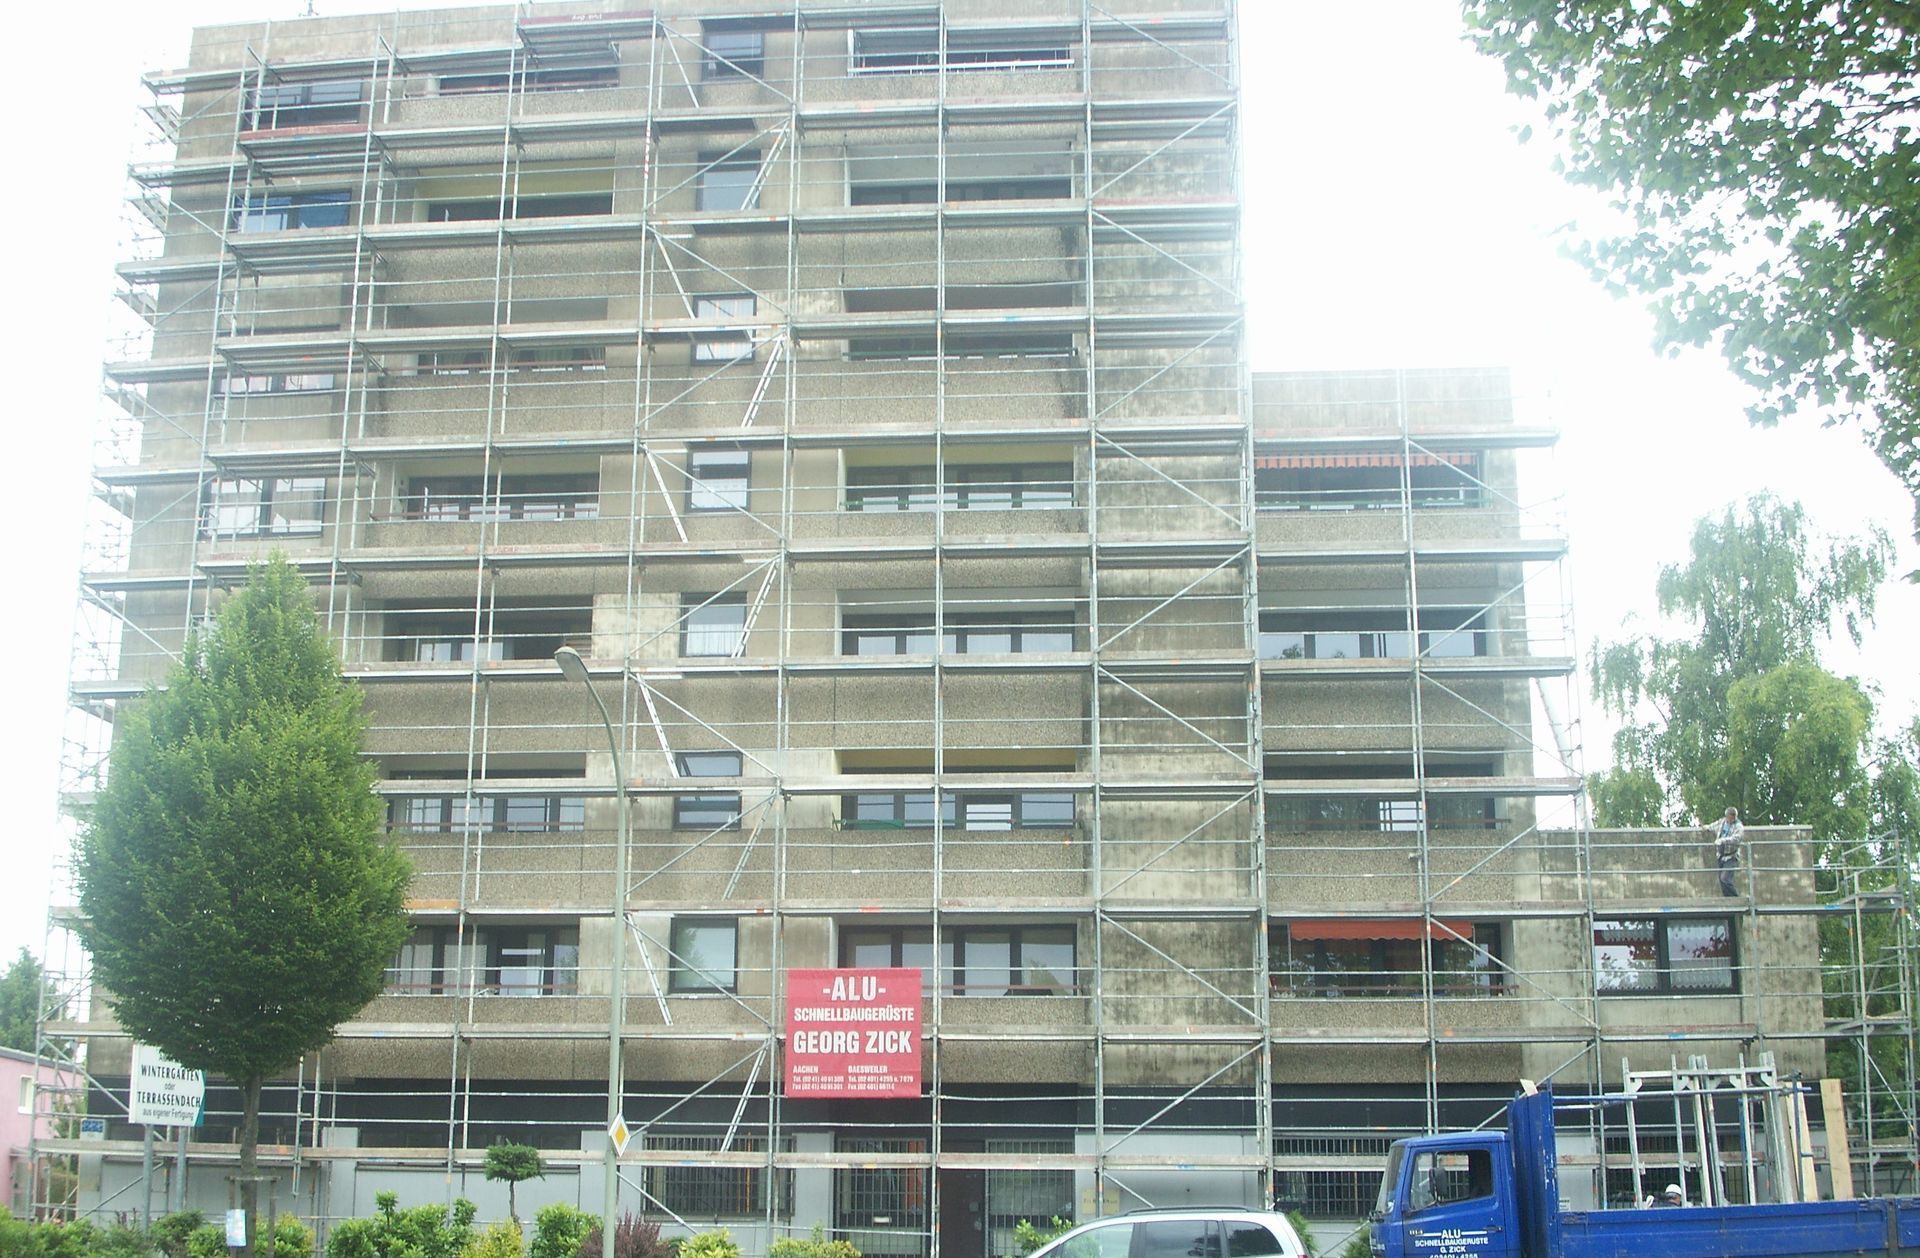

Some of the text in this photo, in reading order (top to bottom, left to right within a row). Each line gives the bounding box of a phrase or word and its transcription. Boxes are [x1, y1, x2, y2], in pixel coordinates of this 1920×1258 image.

[794, 1004, 914, 1021] SCHNELLBAUGERÜSTE
[793, 1030, 912, 1054] GEORG ZICK
[141, 1064, 199, 1081] WINTERGARTEN
[793, 1065, 819, 1074] AACHEN
[848, 1065, 888, 1074] BAESWEILER
[137, 1091, 201, 1107] TERRASSENDACH
